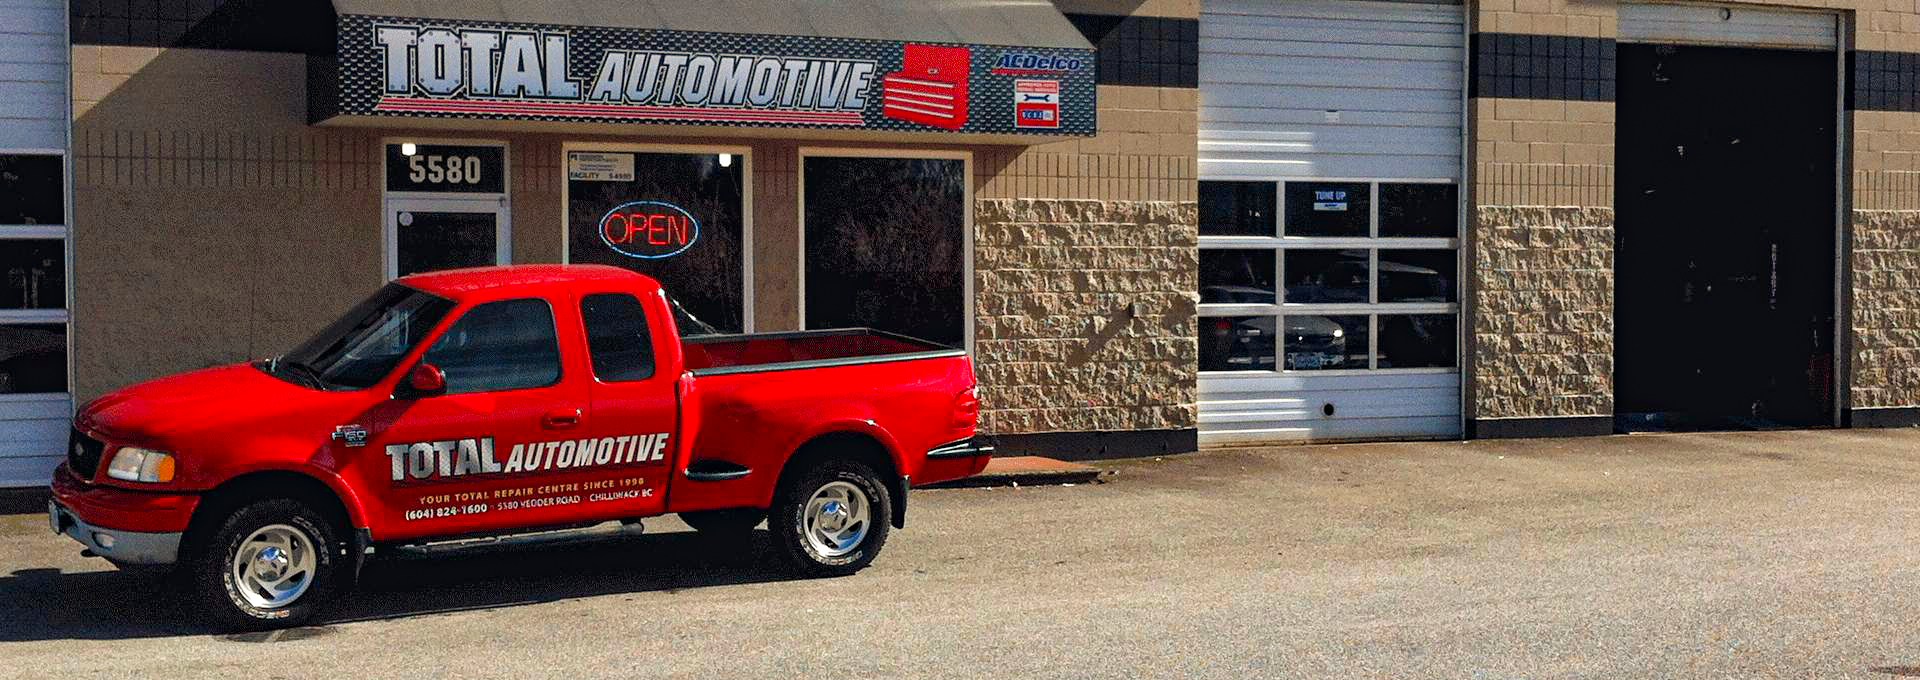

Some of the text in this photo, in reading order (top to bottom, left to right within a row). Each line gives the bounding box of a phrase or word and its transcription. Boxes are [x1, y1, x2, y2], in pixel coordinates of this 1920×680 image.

[374, 24, 877, 110] TOTAL AUTOMOTIVE
[993, 53, 1080, 71] ACDelco
[409, 154, 481, 184] 5580
[1315, 191, 1346, 201] TUNE UP
[605, 213, 689, 246] OPEN
[386, 433, 670, 481] TOTAL AUTOMOTIVE
[420, 495, 451, 505] YOUR
[454, 491, 490, 502] TOTAL
[494, 487, 534, 499] REPAIR
[538, 482, 579, 494] CENTRE
[583, 479, 615, 490] SINCE
[405, 508, 434, 520] (604)
[436, 503, 488, 517] 824-1600
[556, 495, 581, 505] ROAD
